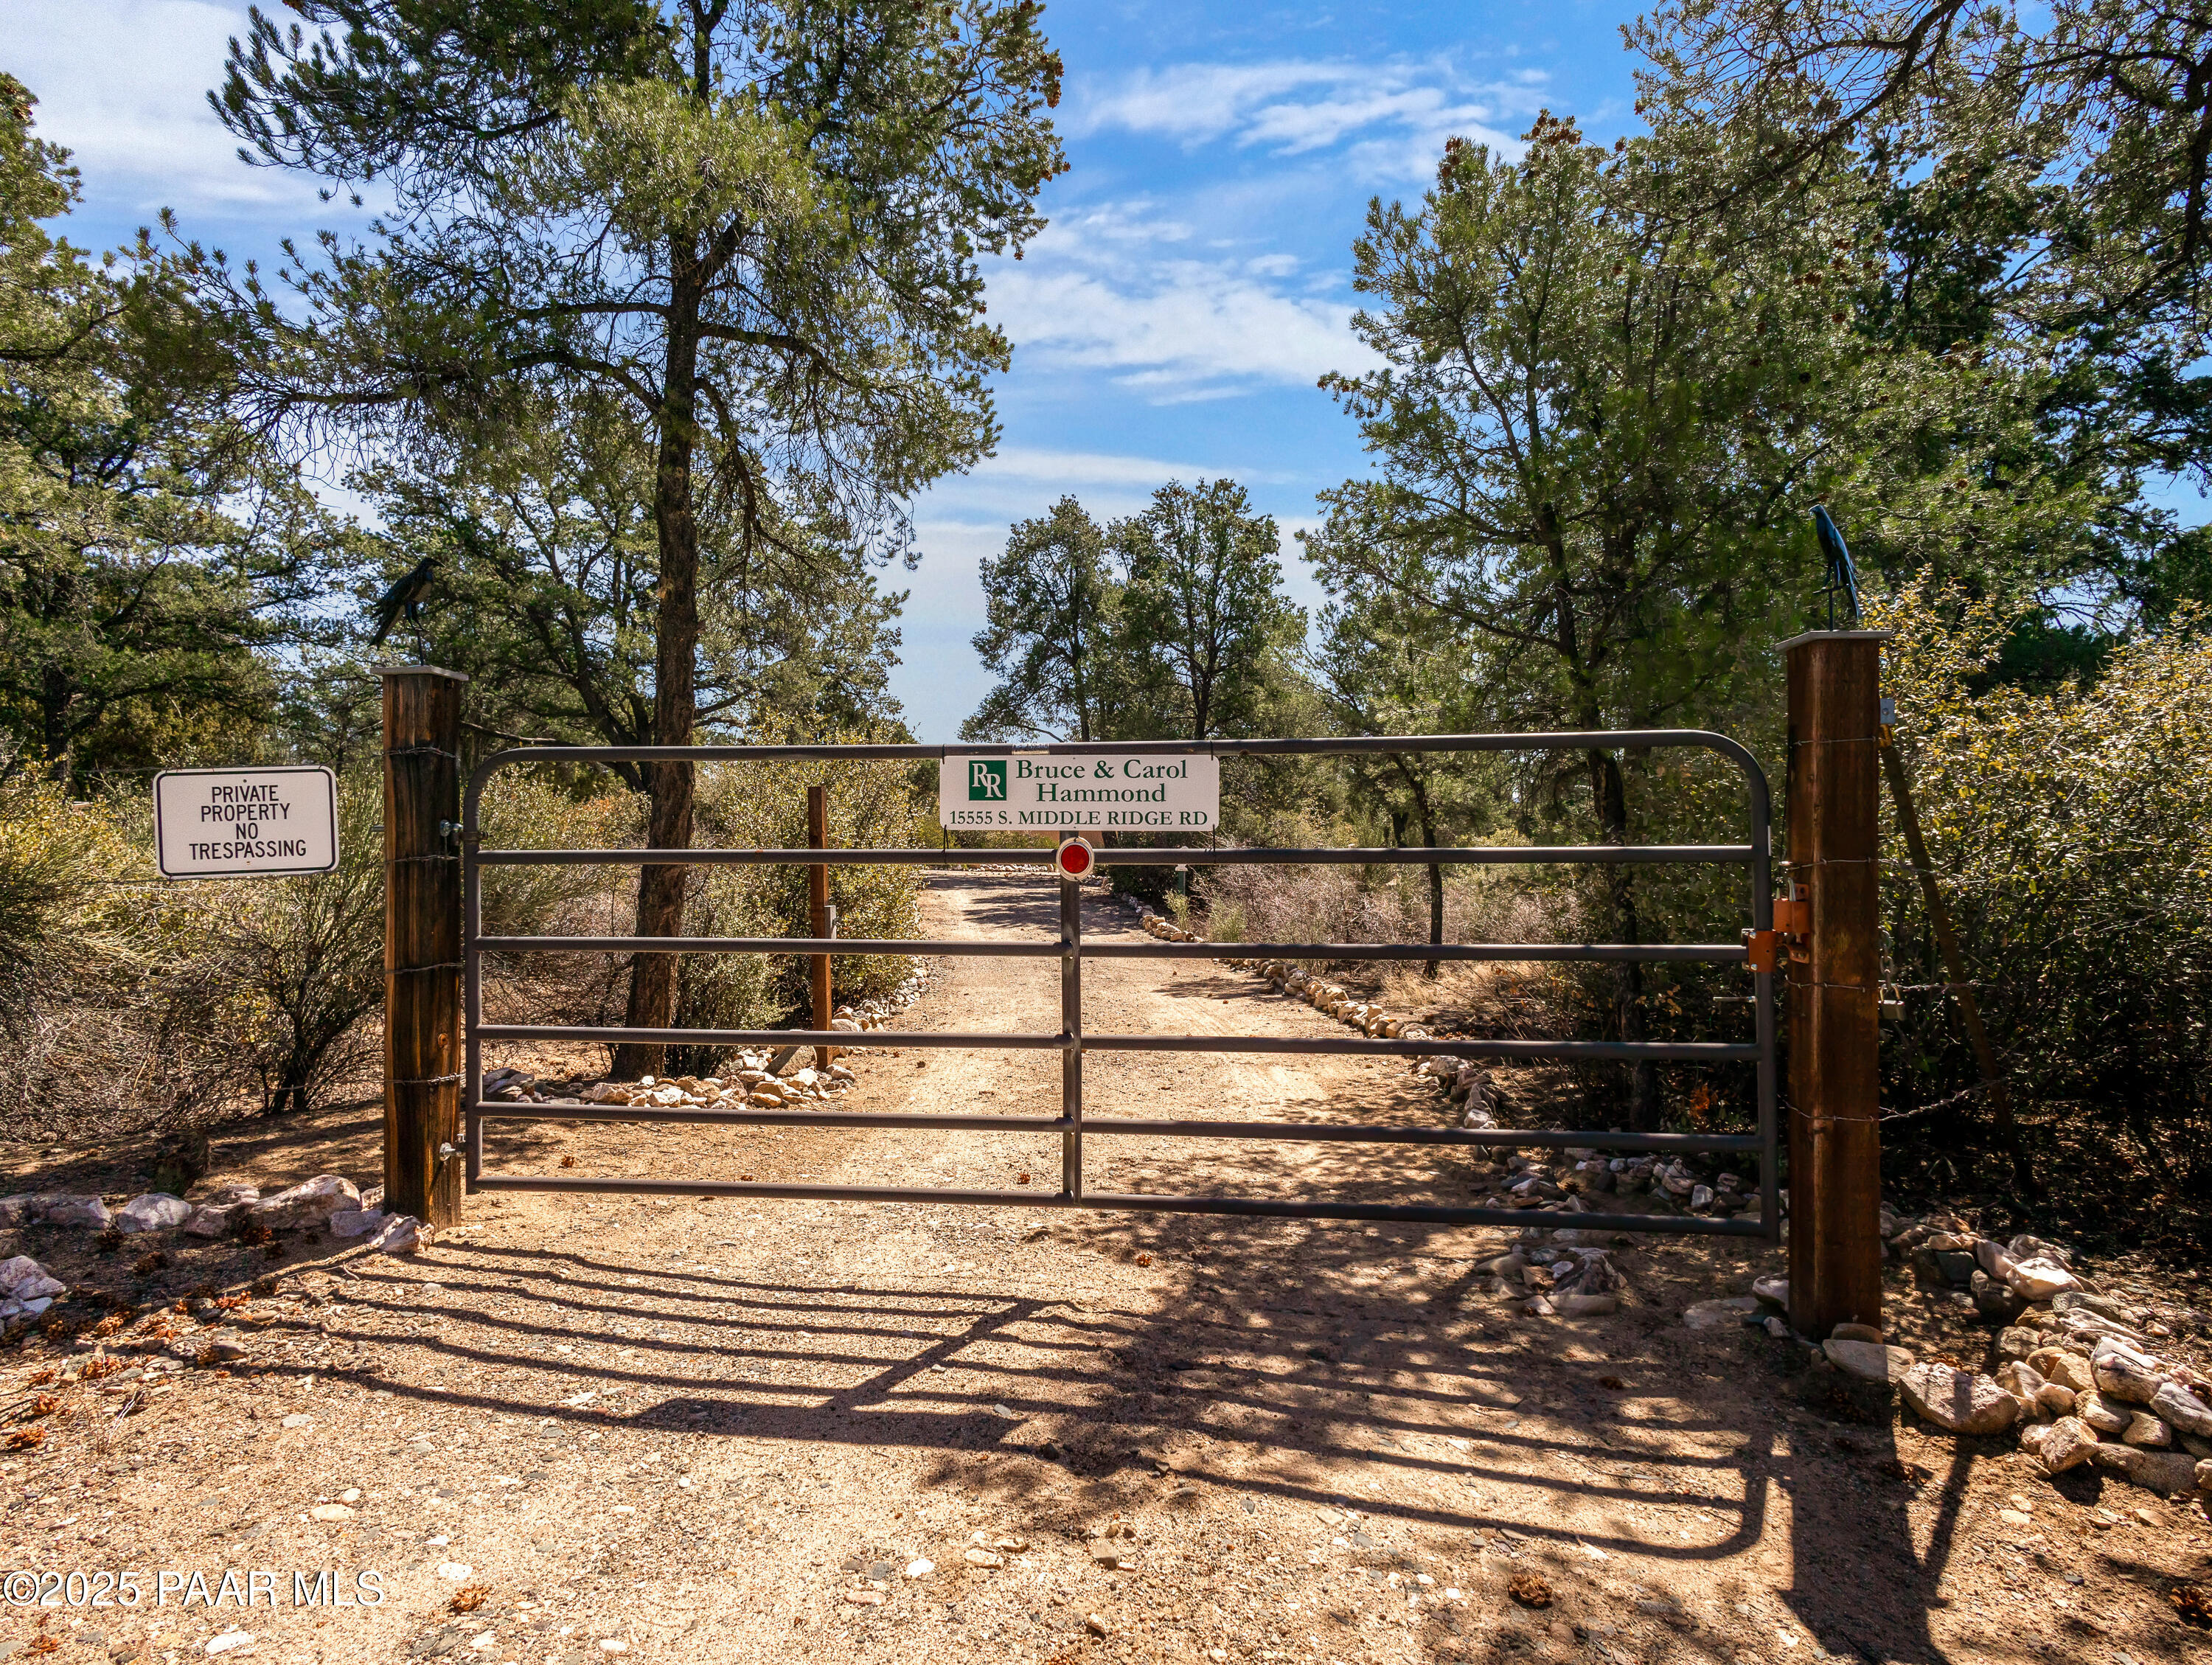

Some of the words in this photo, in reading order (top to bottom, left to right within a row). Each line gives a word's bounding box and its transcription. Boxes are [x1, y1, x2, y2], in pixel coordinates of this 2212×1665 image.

[1015, 759, 1085, 779] Bruce
[1093, 760, 1114, 779] &
[1123, 759, 1189, 779] Carol
[212, 785, 279, 803] PRIVATE
[1036, 783, 1166, 802] Hammond
[201, 802, 291, 822] PROPERTY
[950, 811, 993, 825] 15555
[998, 810, 1012, 825] S.
[1018, 811, 1100, 825] MIDDLE
[1107, 811, 1173, 825] RIDGE
[1179, 811, 1208, 825] RD
[235, 822, 258, 840] NO
[189, 839, 307, 860] TRESPASSING
